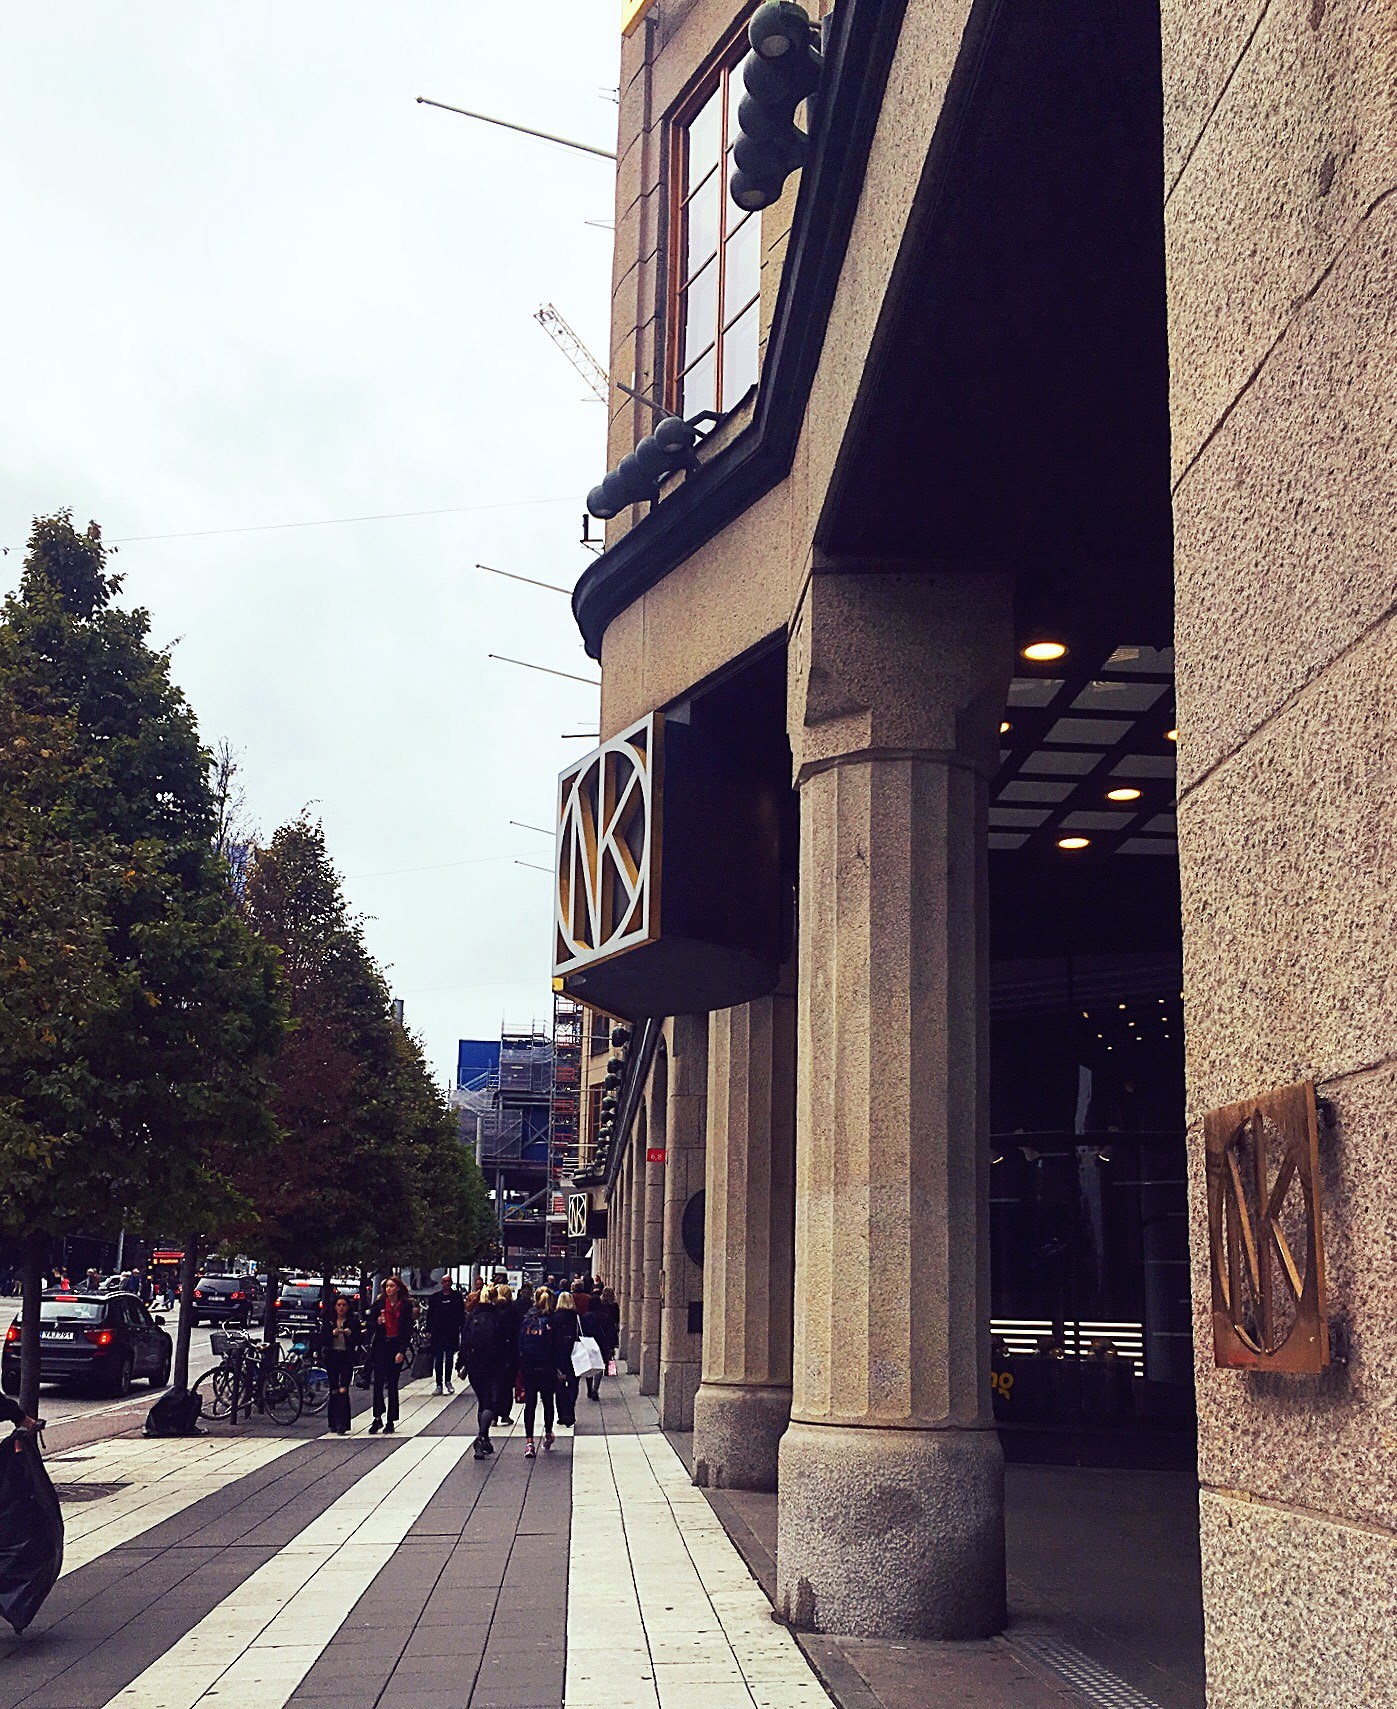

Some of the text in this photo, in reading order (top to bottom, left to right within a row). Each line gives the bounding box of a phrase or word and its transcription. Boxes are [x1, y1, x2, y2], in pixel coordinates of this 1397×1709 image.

[563, 745, 646, 954] NK
[569, 1194, 587, 1237] NK
[1220, 1106, 1308, 1354] NK
